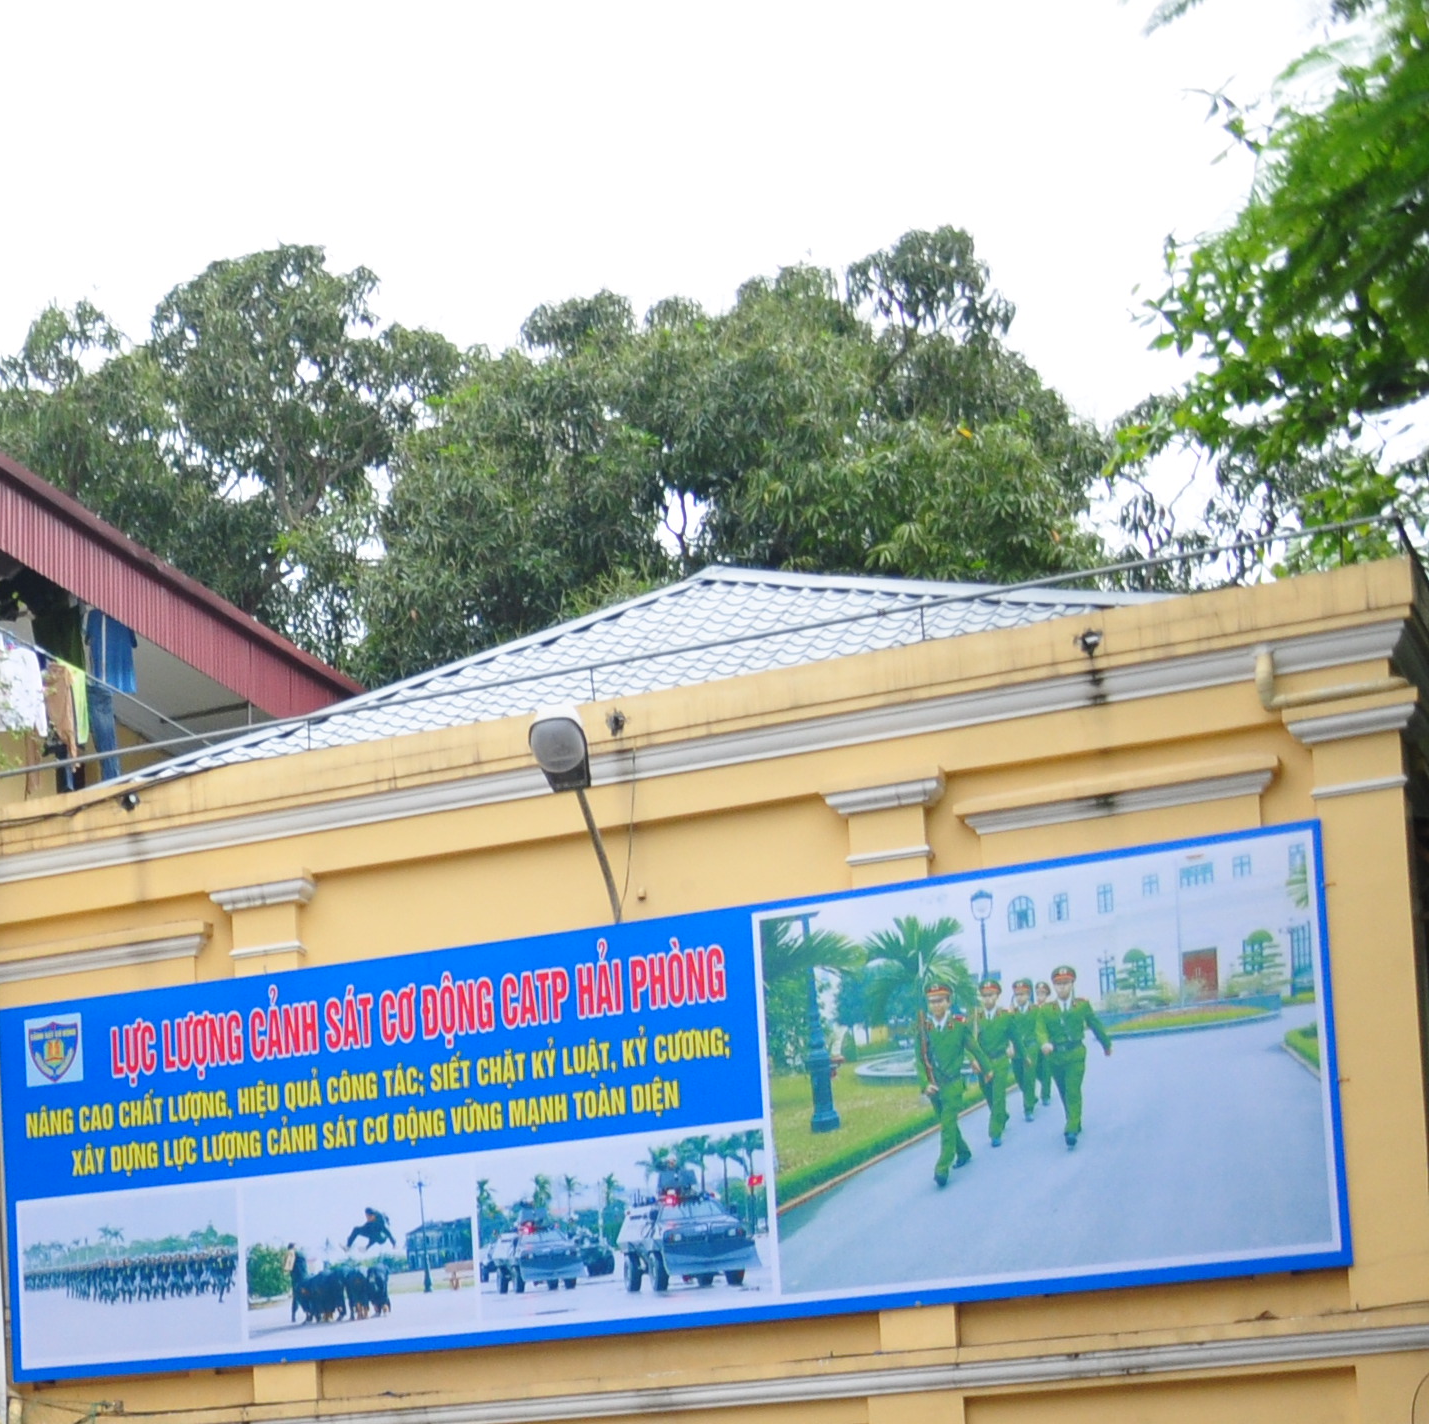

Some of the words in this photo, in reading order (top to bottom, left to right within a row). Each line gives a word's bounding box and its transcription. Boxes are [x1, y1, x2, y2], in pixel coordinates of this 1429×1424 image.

[110, 1017, 156, 1087] LỰC
[162, 1011, 243, 1079] LƯỢNG
[249, 984, 319, 1062] CẢNH
[324, 984, 373, 1051] SÁT
[379, 983, 416, 1045] CƠ
[421, 971, 493, 1049] ĐỘNG
[501, 967, 568, 1029] CATP
[576, 938, 623, 1019] HẢI
[629, 937, 726, 1012] PHÒNG
[26, 1106, 73, 1138] NÂNG
[79, 1102, 113, 1132] CAO
[119, 1088, 163, 1127] CHẤT
[168, 1091, 233, 1126] LƯỢNG,
[238, 1080, 279, 1121] HIỆU
[284, 1067, 321, 1108] QUẢ
[327, 1072, 377, 1104] CÔNG
[382, 1062, 425, 1097] TÁC;
[430, 1051, 470, 1092] SIẾT
[477, 1048, 525, 1090] CHẶT
[531, 1037, 556, 1078] KỶ
[562, 1038, 617, 1078] LUẬT,
[622, 1025, 648, 1068] KỶ
[654, 1027, 731, 1062] CƯƠNG;
[72, 1143, 105, 1176] XÂY
[110, 1141, 159, 1176] DỰNG
[163, 1138, 198, 1173] LỰC
[202, 1131, 261, 1166] LƯỢNG
[267, 1115, 317, 1155] CẢNH
[323, 1115, 356, 1150] SÁT
[363, 1113, 389, 1144] CƠ
[393, 1106, 445, 1146] ĐỘNG
[451, 1099, 503, 1134] VỮNG
[508, 1092, 568, 1131] MẠNH
[573, 1083, 626, 1120] TOÀN
[631, 1076, 680, 1117] DIỆN
